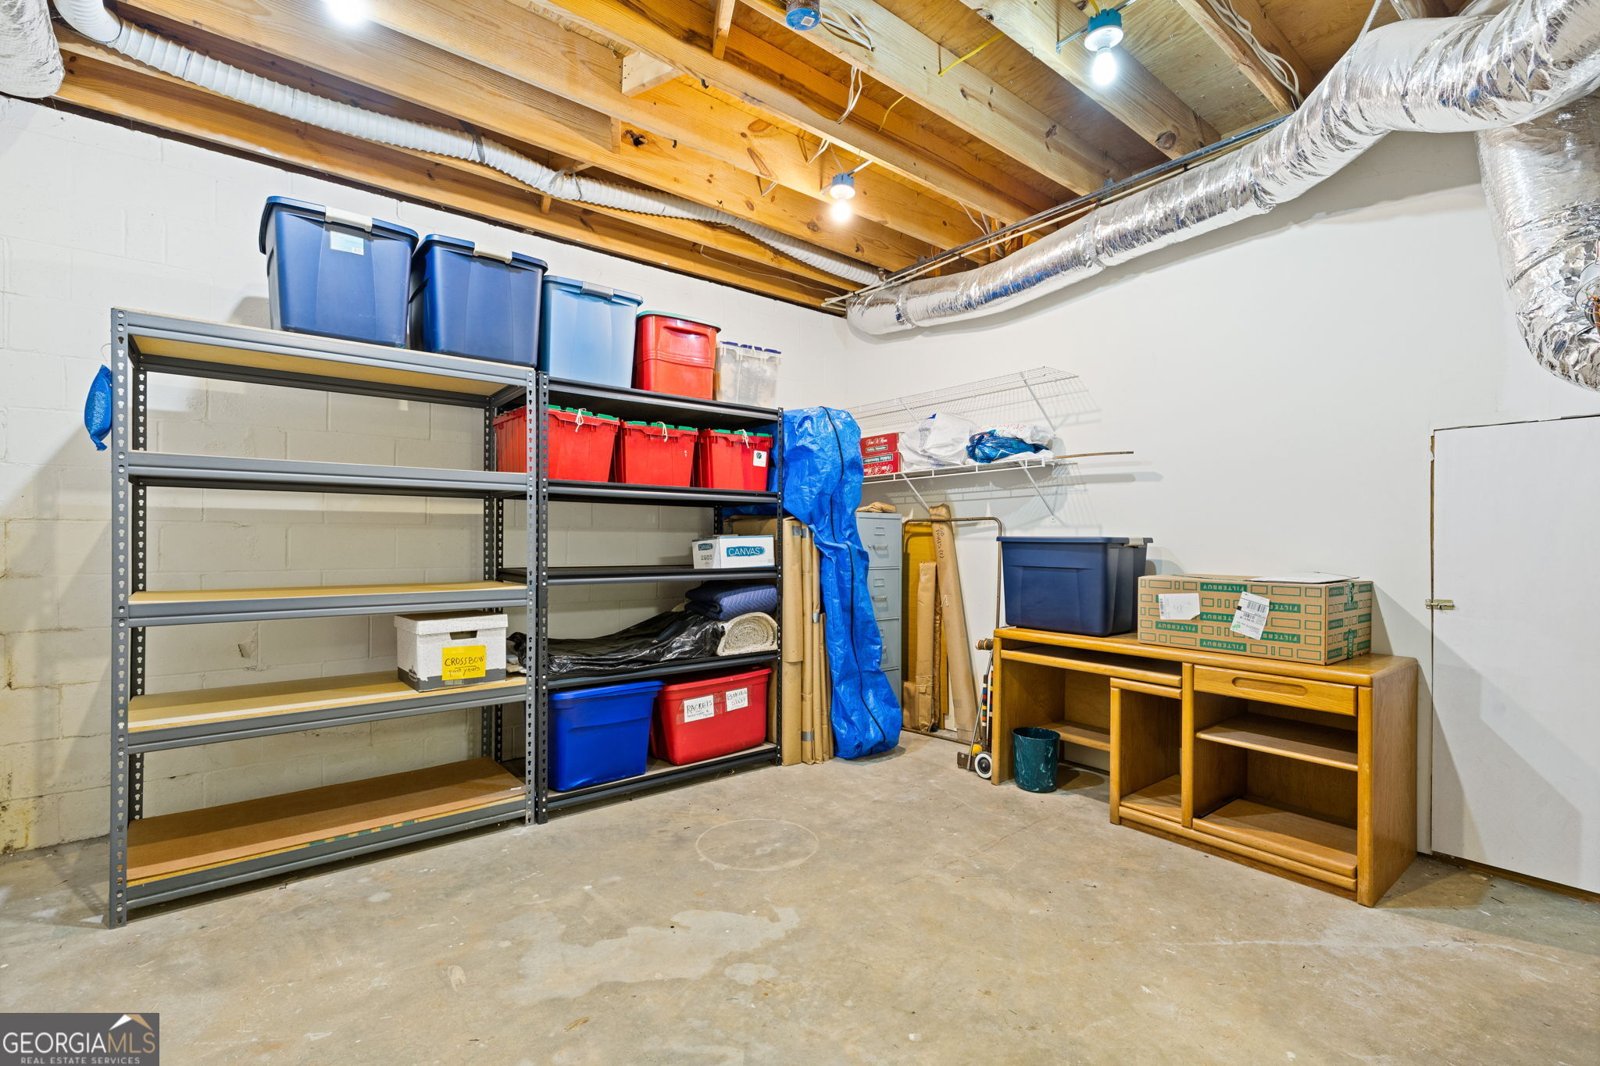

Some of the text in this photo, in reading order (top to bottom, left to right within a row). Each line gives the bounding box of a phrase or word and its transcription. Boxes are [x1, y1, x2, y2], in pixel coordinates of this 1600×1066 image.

[728, 547, 761, 556] CANVAS
[1203, 584, 1245, 592] FILTERBUY
[1158, 622, 1197, 631] FILTERBUY
[1262, 633, 1297, 641] FILTERB
[1203, 641, 1244, 650] FILTERBUY
[444, 656, 484, 666] CROSSBOW
